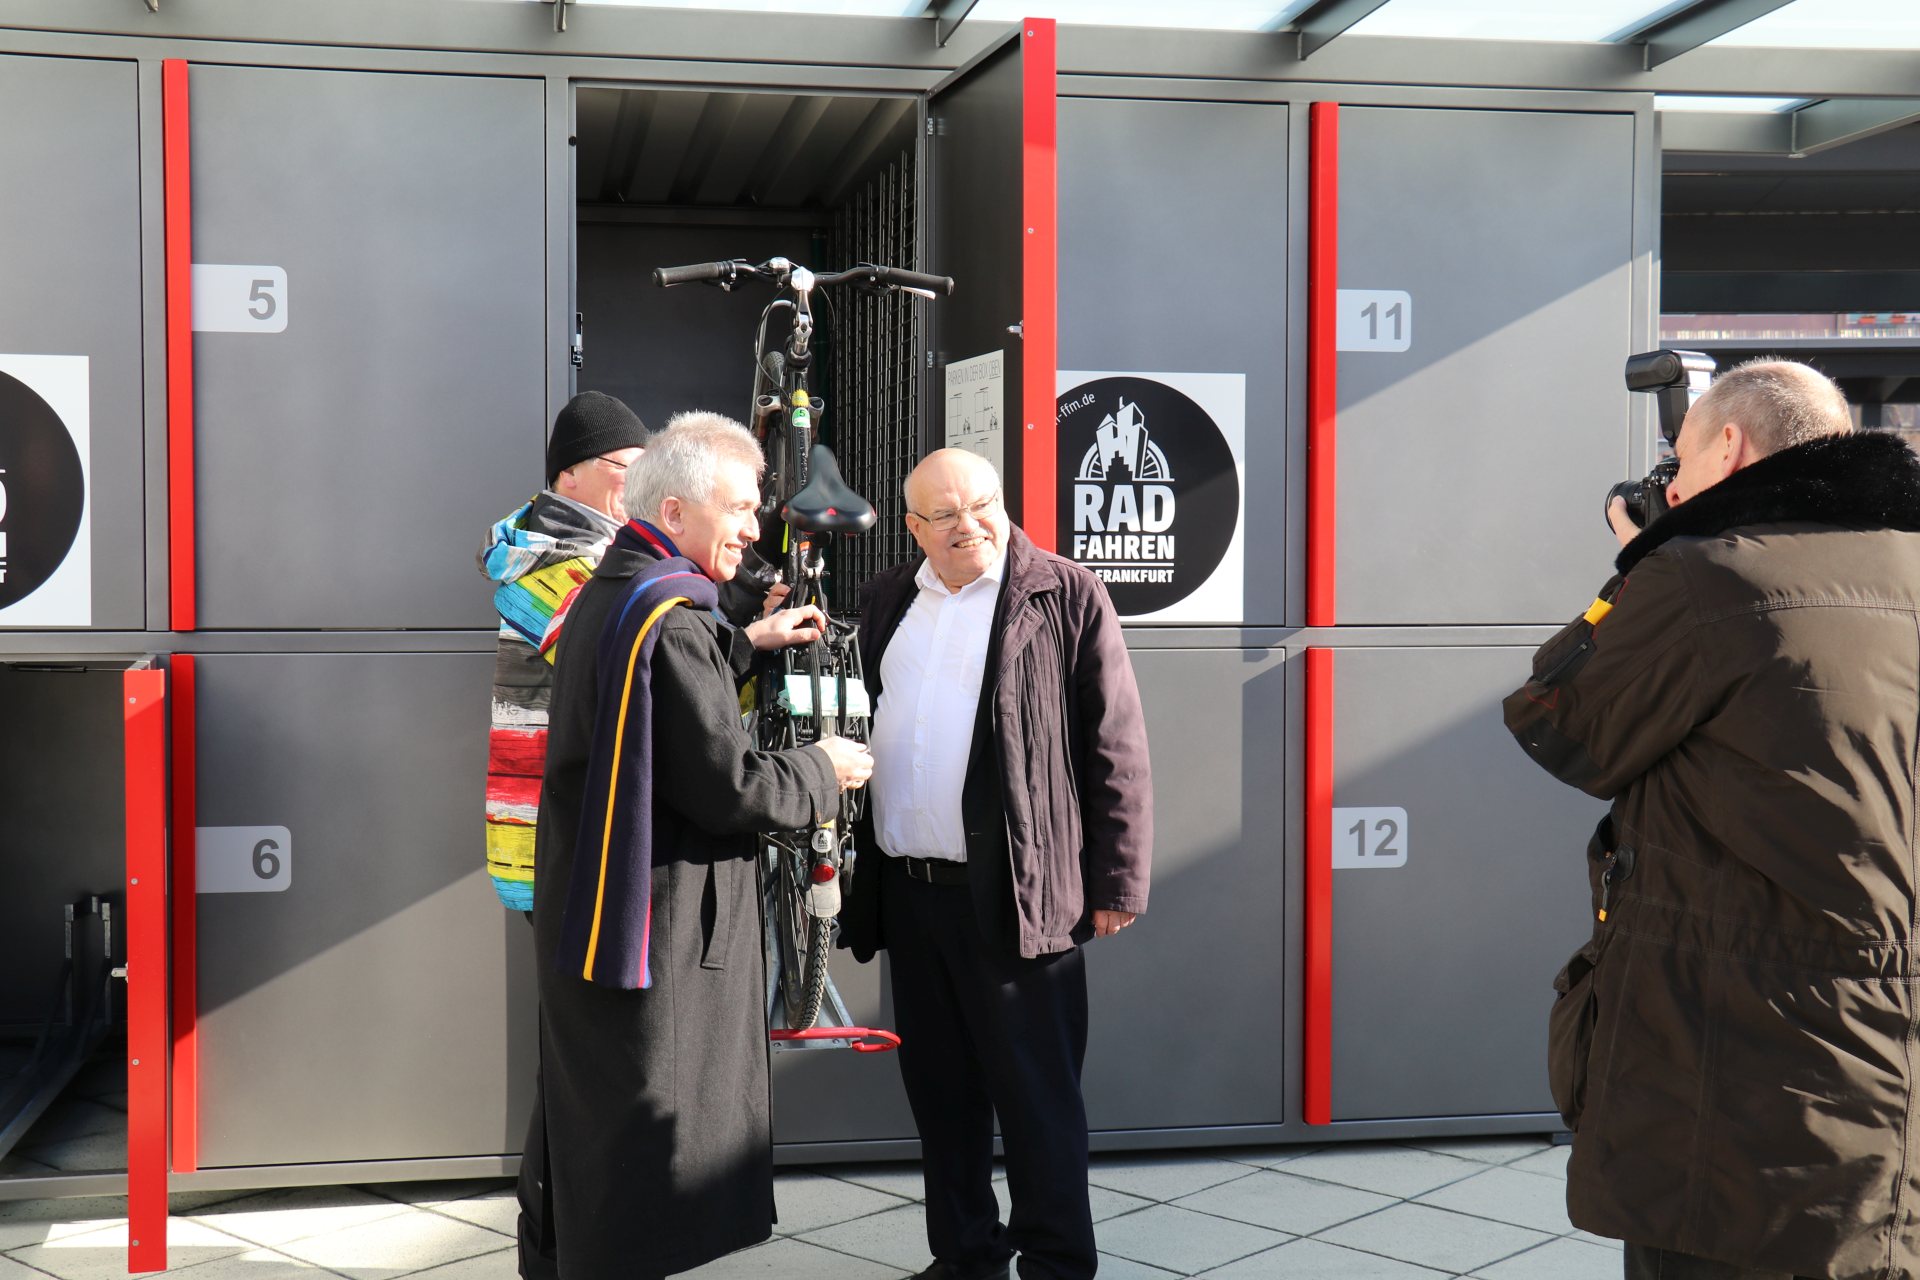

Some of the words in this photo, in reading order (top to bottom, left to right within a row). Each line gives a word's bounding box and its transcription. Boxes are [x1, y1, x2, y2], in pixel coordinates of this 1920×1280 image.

[248, 279, 276, 321] 5
[1361, 302, 1402, 340] 11
[1074, 484, 1176, 533] RAD
[1073, 535, 1175, 560] FAHREN
[1349, 819, 1398, 856] 12
[252, 838, 281, 880] 6
